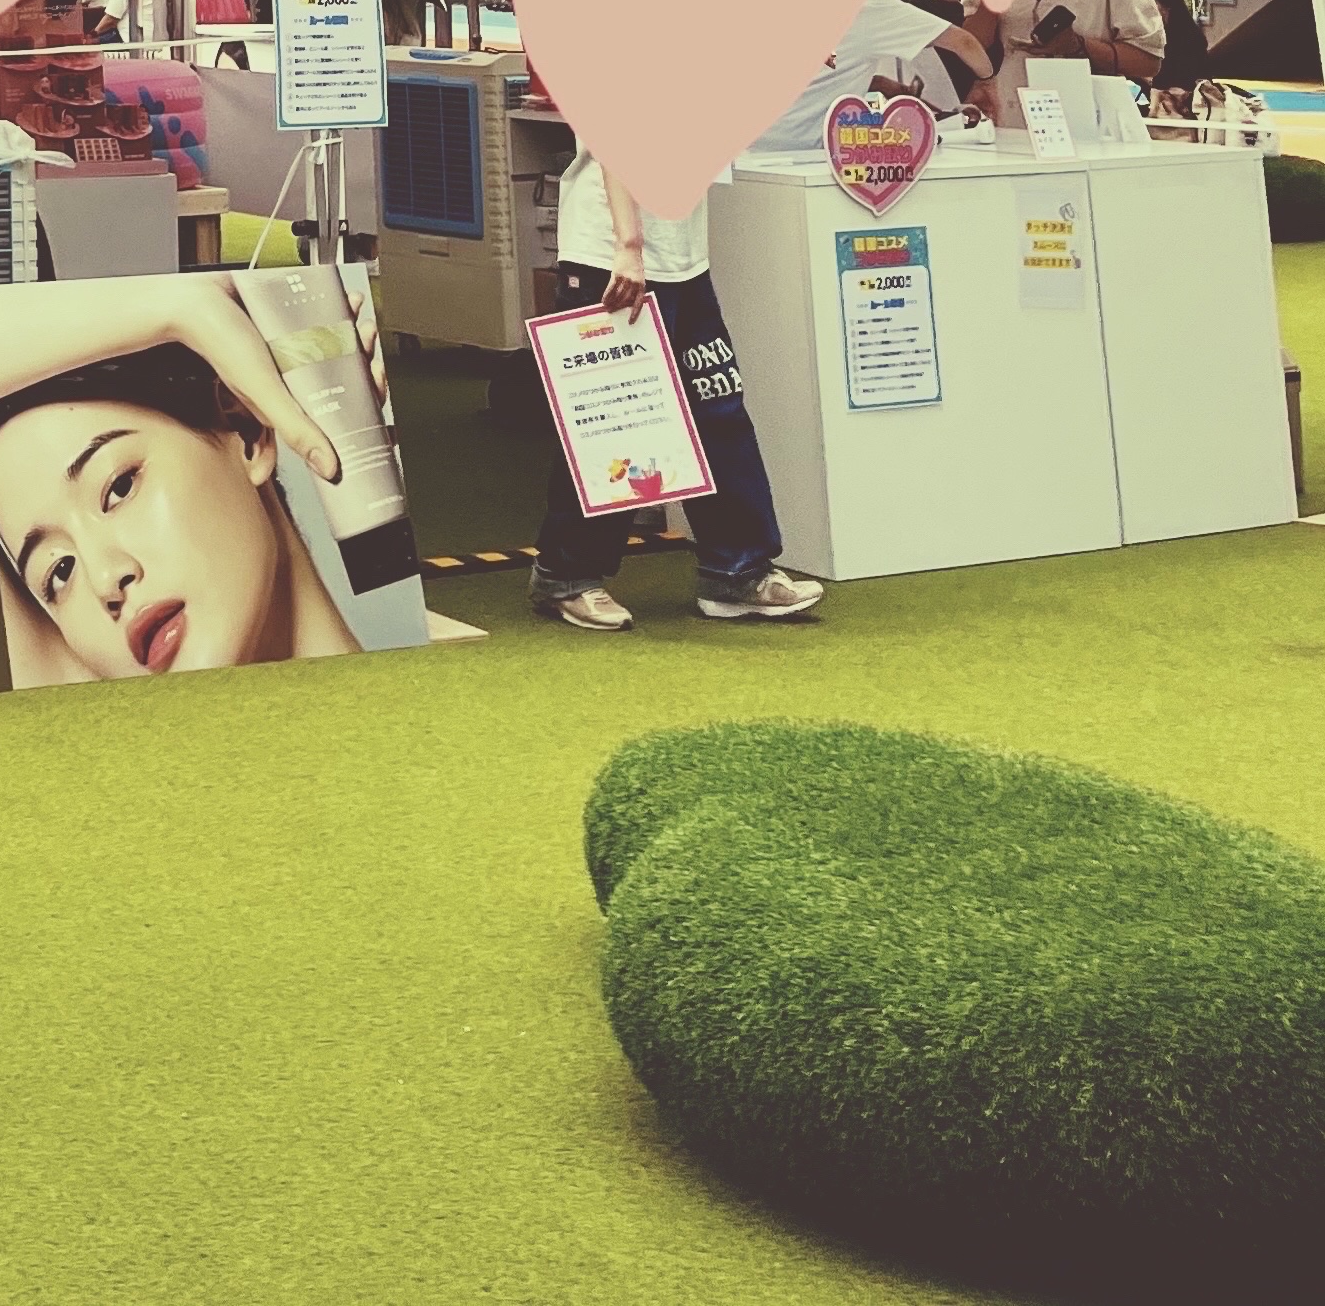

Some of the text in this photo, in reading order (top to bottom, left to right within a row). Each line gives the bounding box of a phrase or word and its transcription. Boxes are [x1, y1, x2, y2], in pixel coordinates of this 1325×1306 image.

[562, 343, 648, 370] ご来場の皆様へ
